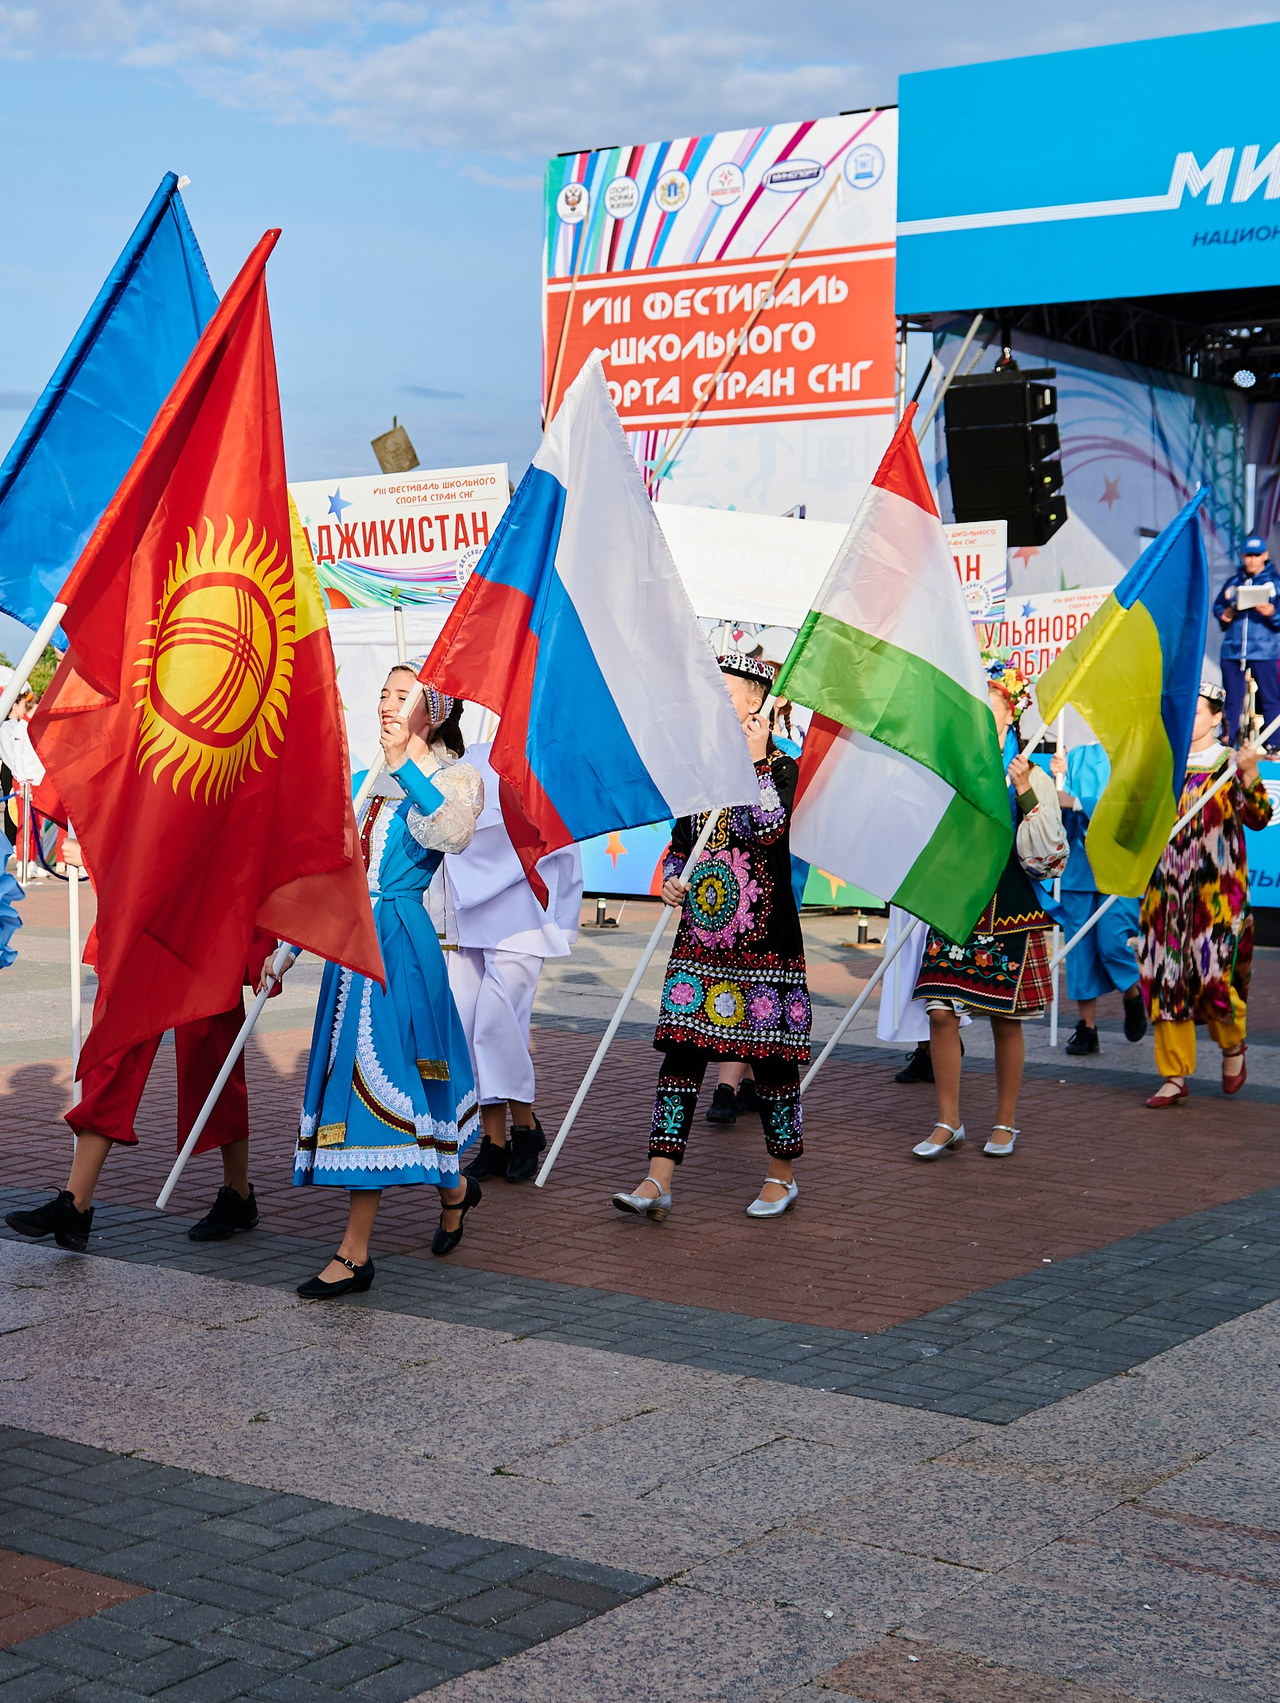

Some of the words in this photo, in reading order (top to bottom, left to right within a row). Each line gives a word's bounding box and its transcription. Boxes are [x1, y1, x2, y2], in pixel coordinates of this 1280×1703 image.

[642, 275, 849, 320] ФЕСТИВАЛЬ
[610, 321, 816, 366] ШКОЛЬНОГО
[692, 367, 795, 401] СТРАН
[807, 360, 874, 394] СНГ
[388, 482, 440, 495] ФЕСТИВАЛЬ
[442, 476, 496, 489] ШКОЛЬНОГО
[395, 494, 428, 505] СПОРТА
[430, 492, 457, 501] СТРАН
[459, 489, 476, 499] СНГ
